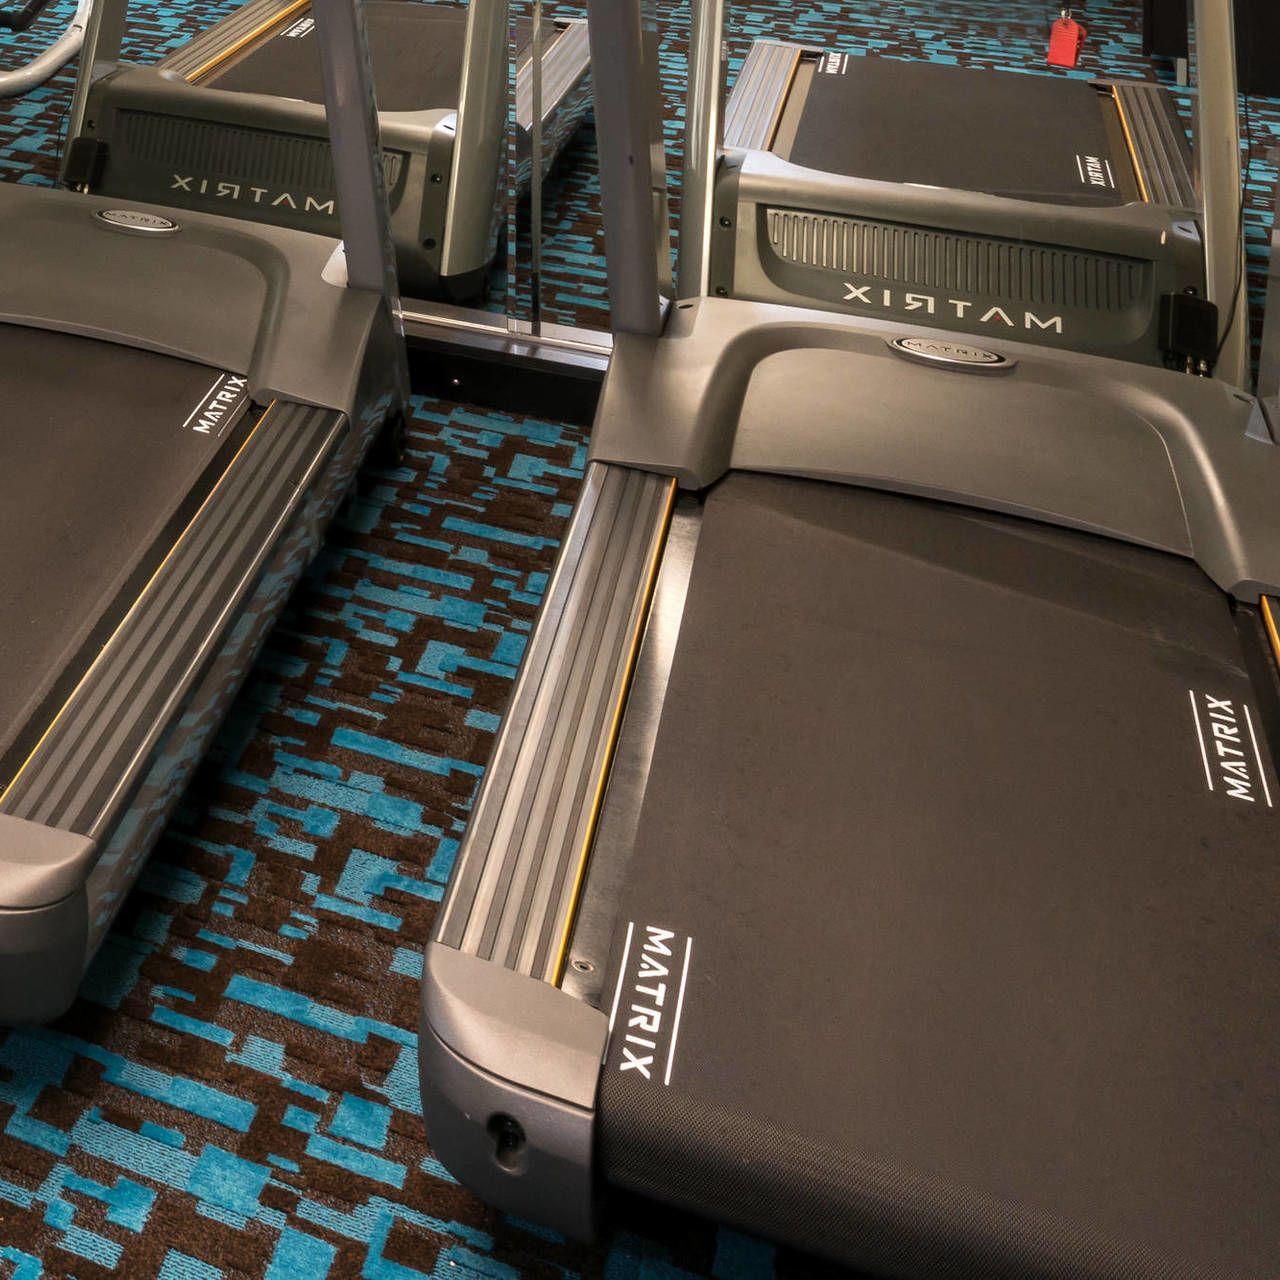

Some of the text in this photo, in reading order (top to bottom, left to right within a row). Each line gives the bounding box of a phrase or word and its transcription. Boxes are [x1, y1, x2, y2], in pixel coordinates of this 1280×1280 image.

[907, 341, 993, 359] MATRIX
[193, 376, 248, 434] MATRIX
[1205, 694, 1255, 802] MATRIX
[620, 926, 674, 1079] MATRIX
